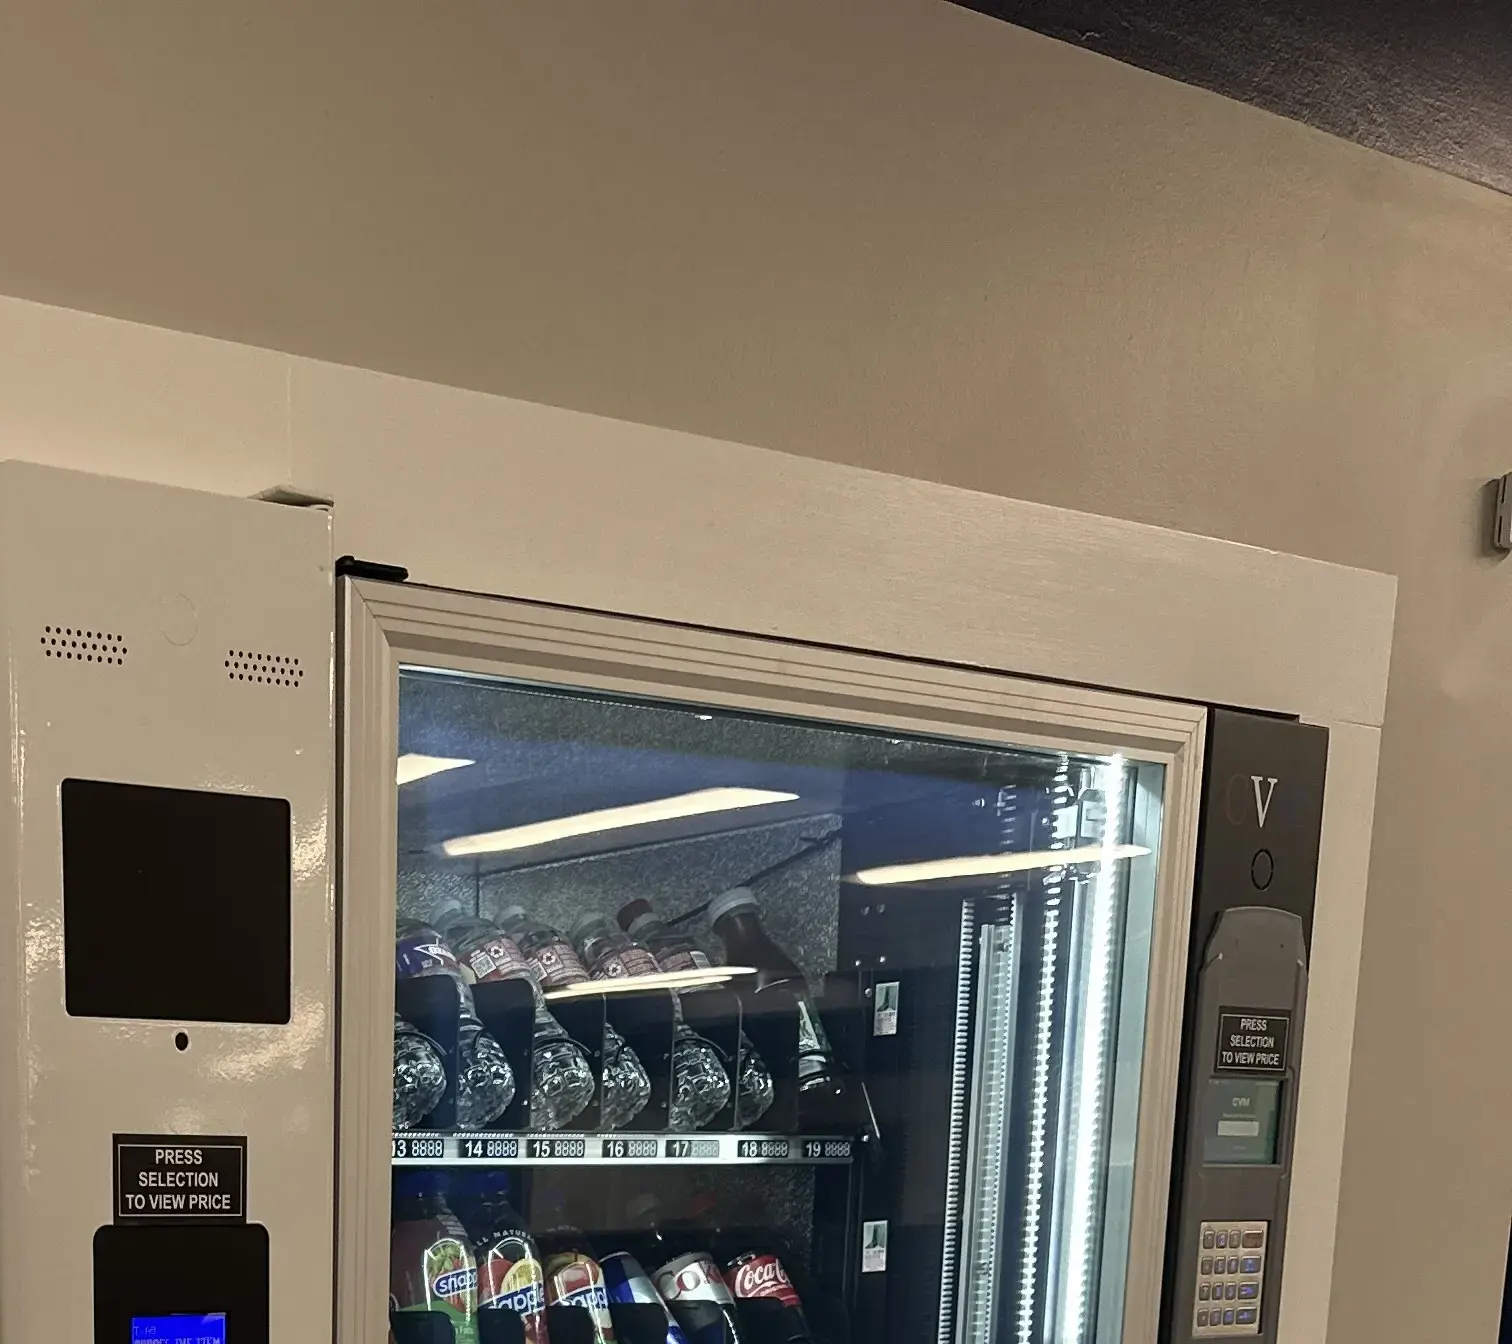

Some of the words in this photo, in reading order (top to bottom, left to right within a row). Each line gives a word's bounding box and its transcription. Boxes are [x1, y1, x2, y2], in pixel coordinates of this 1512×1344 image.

[1250, 775, 1278, 828] V
[1240, 1017, 1268, 1032] PRESS
[1229, 1034, 1275, 1048] SELECTION
[1221, 1051, 1233, 1064] TO
[1234, 1052, 1255, 1065] VIEW
[1256, 1053, 1280, 1066] PRICE
[155, 1148, 203, 1165] PRESS
[465, 1140, 483, 1158] 14
[533, 1140, 551, 1158] 15
[607, 1140, 624, 1158] 16
[672, 1140, 689, 1158] 17
[805, 1141, 822, 1158] 19
[138, 1171, 220, 1188] SELECTION
[125, 1194, 146, 1210] TO
[148, 1194, 186, 1210] VIEW
[188, 1193, 232, 1210] PRICE
